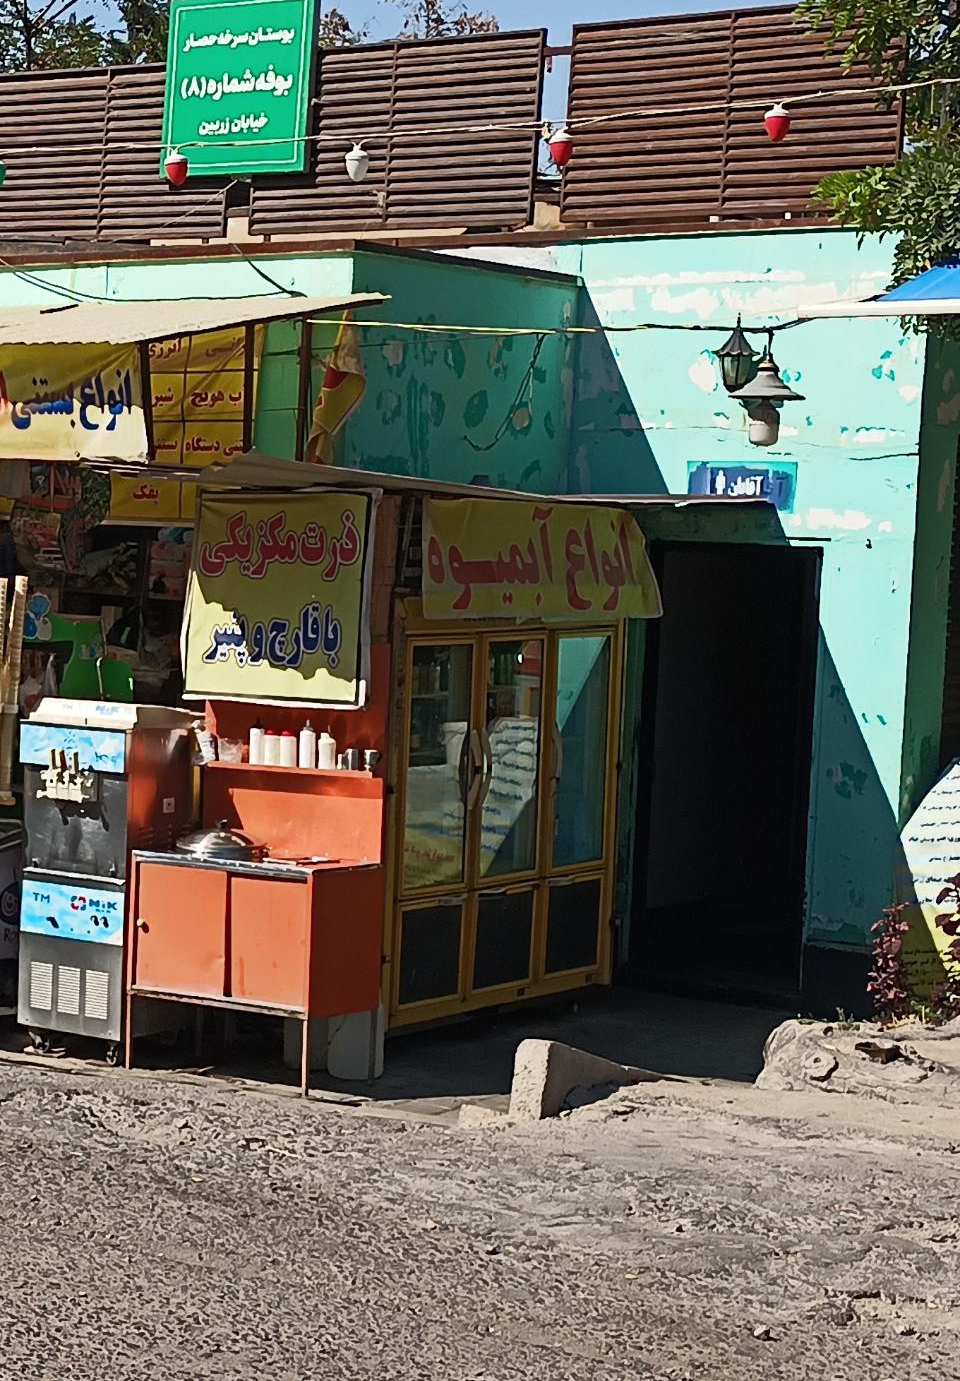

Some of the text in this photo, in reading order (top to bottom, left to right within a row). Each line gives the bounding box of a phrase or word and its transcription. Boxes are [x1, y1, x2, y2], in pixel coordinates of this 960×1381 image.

[183, 26, 295, 52] بوستان سرخه حصار
[207, 68, 255, 101] شماره
[255, 63, 294, 96] بوفه
[230, 111, 269, 133] خیابان
[11, 375, 75, 431] بستنی
[79, 368, 133, 431] انواع
[190, 389, 225, 408] هویج
[185, 437, 220, 452] دستگاه
[726, 474, 764, 497] آقایان
[200, 509, 360, 581] ذرت مکزیکی
[427, 505, 637, 611] انواع آبمیوه
[202, 601, 342, 667] با قارچ و پنیر
[32, 891, 51, 904] TM
